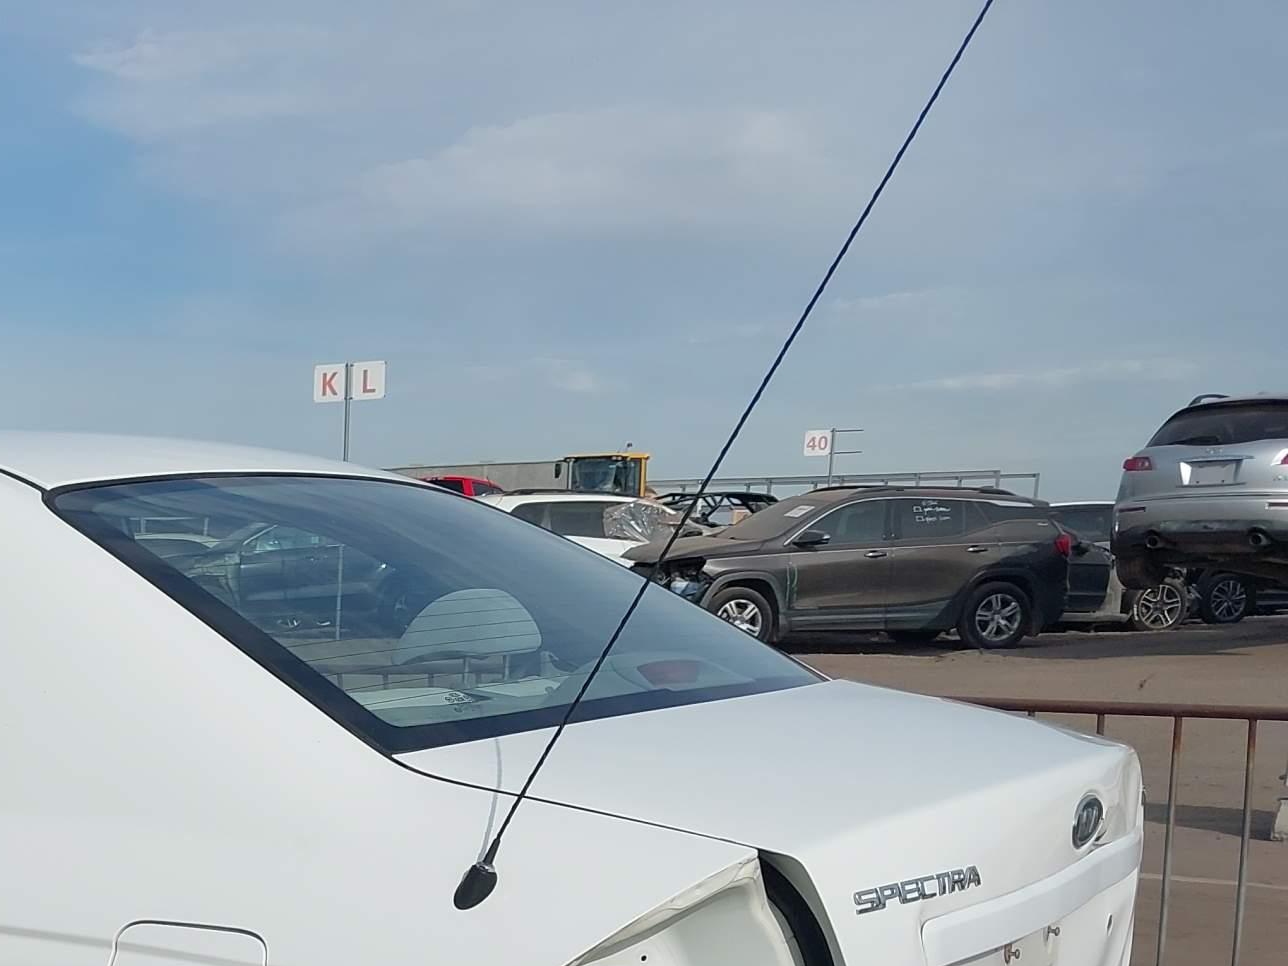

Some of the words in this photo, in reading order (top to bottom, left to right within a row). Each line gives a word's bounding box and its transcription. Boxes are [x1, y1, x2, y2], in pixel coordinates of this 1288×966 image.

[321, 371, 338, 396] K
[362, 369, 376, 394] L
[806, 435, 829, 451] 40
[853, 864, 982, 915] SPECTRA
